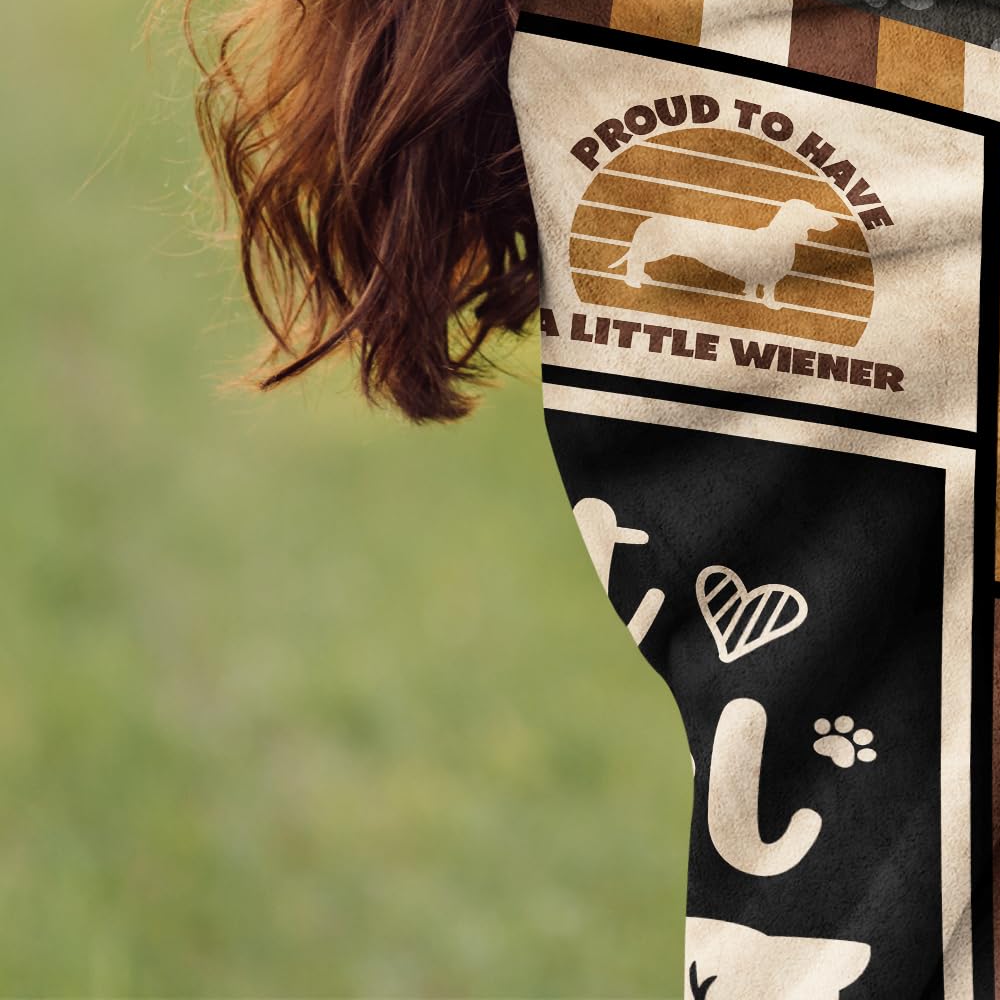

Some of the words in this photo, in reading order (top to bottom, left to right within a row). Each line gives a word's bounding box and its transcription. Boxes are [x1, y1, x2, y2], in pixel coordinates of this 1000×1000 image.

[570, 94, 720, 171] PROUD
[734, 99, 794, 142] TO
[797, 131, 895, 231] HAVE
[570, 313, 720, 361] LITTLE
[730, 339, 905, 393] WIENER
